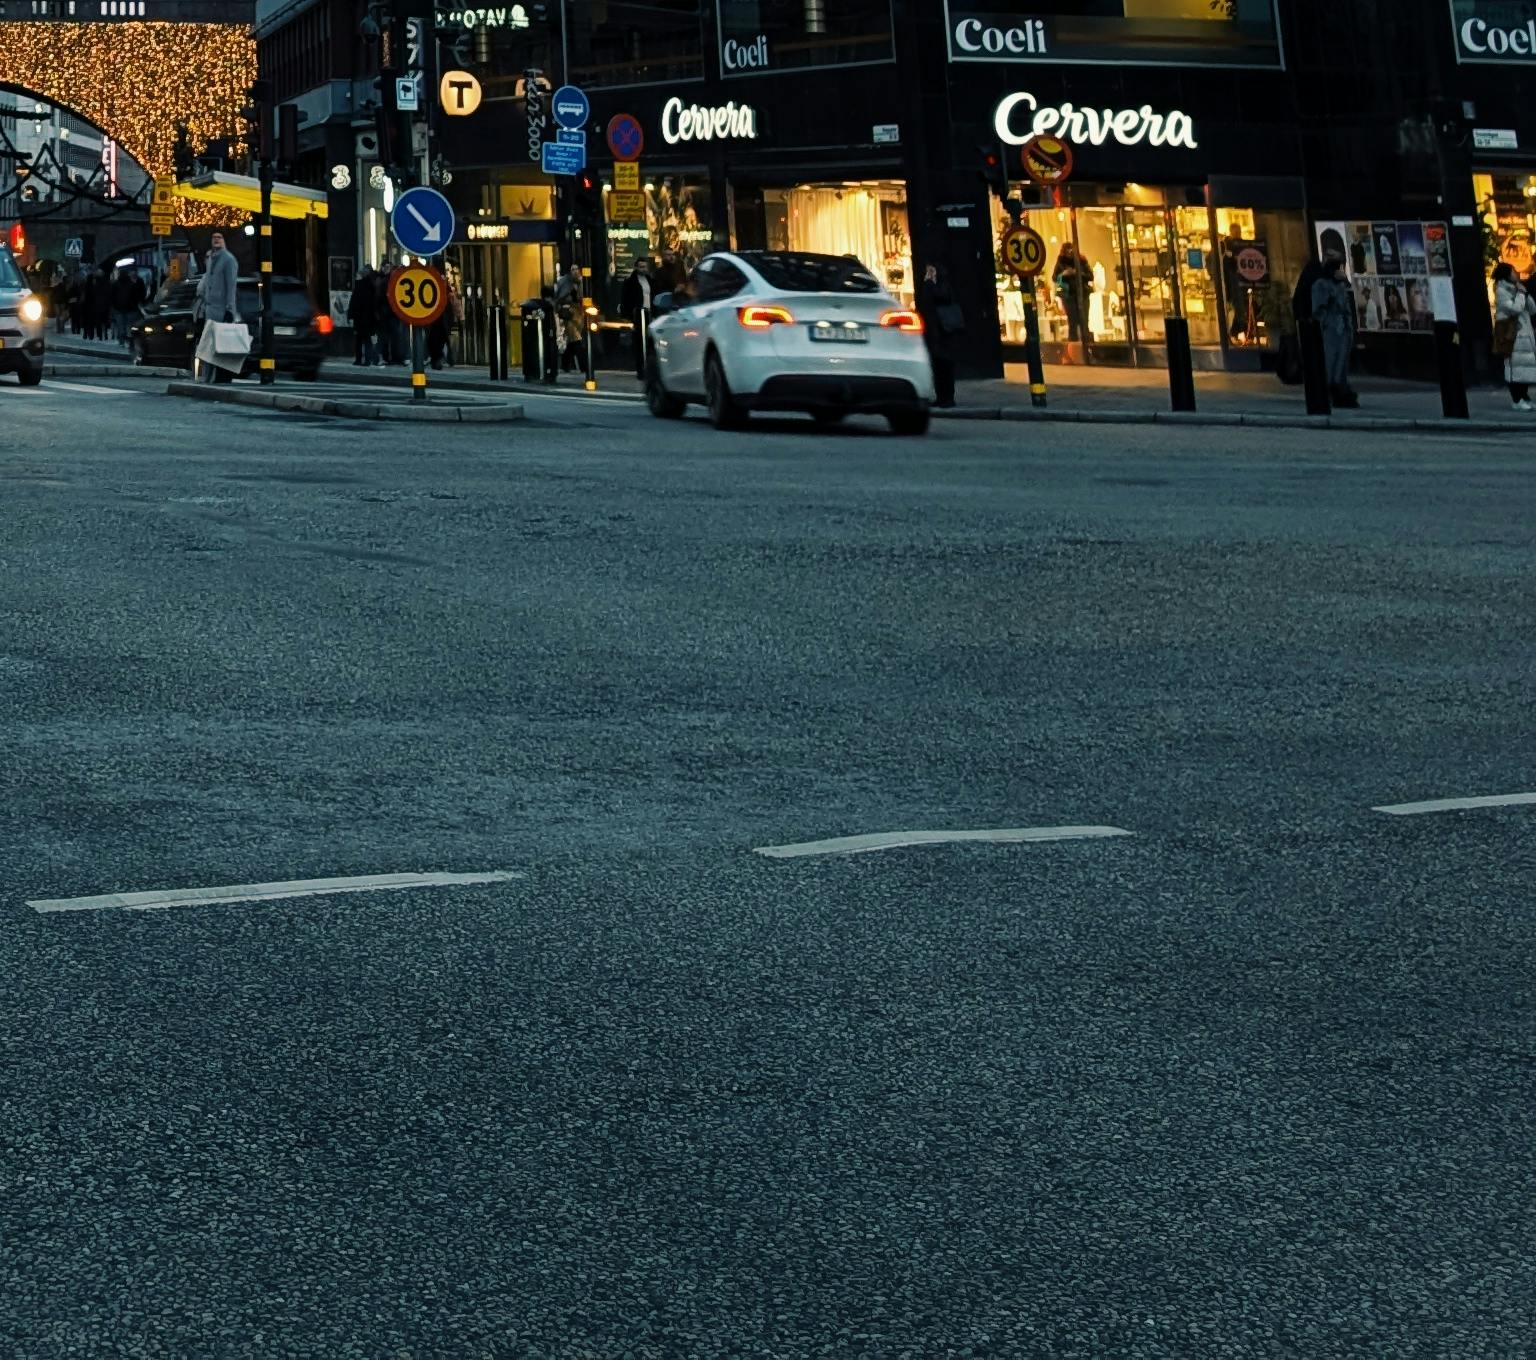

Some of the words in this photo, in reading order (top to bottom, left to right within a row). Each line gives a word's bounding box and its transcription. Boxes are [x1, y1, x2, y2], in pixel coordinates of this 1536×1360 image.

[724, 34, 768, 69] Coeli
[955, 18, 1047, 53] Coeli
[1461, 18, 1536, 54] Coel
[449, 80, 473, 109] T
[662, 96, 756, 145] Cervera
[994, 92, 1198, 149] Cervera
[1010, 239, 1040, 264] 30
[399, 278, 438, 309] 30
